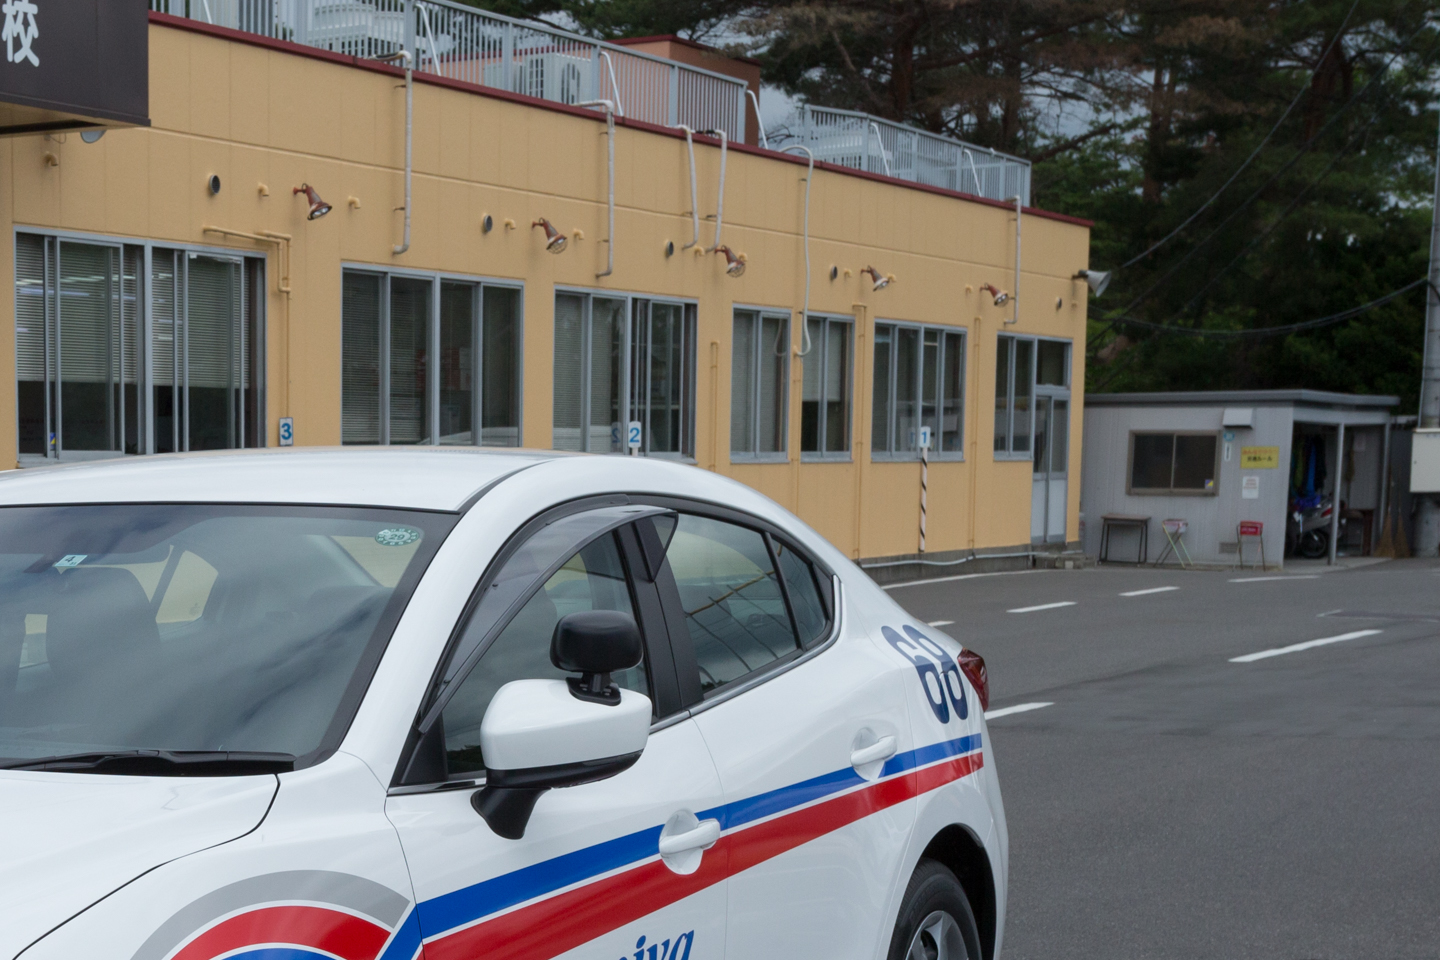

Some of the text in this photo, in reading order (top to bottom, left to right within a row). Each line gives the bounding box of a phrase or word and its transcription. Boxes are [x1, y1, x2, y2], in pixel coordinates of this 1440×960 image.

[281, 422, 292, 440] 3
[629, 427, 640, 443] 2
[921, 431, 927, 444] 1
[389, 533, 406, 541] 29
[64, 555, 76, 563] 4
[881, 624, 969, 725] 68
